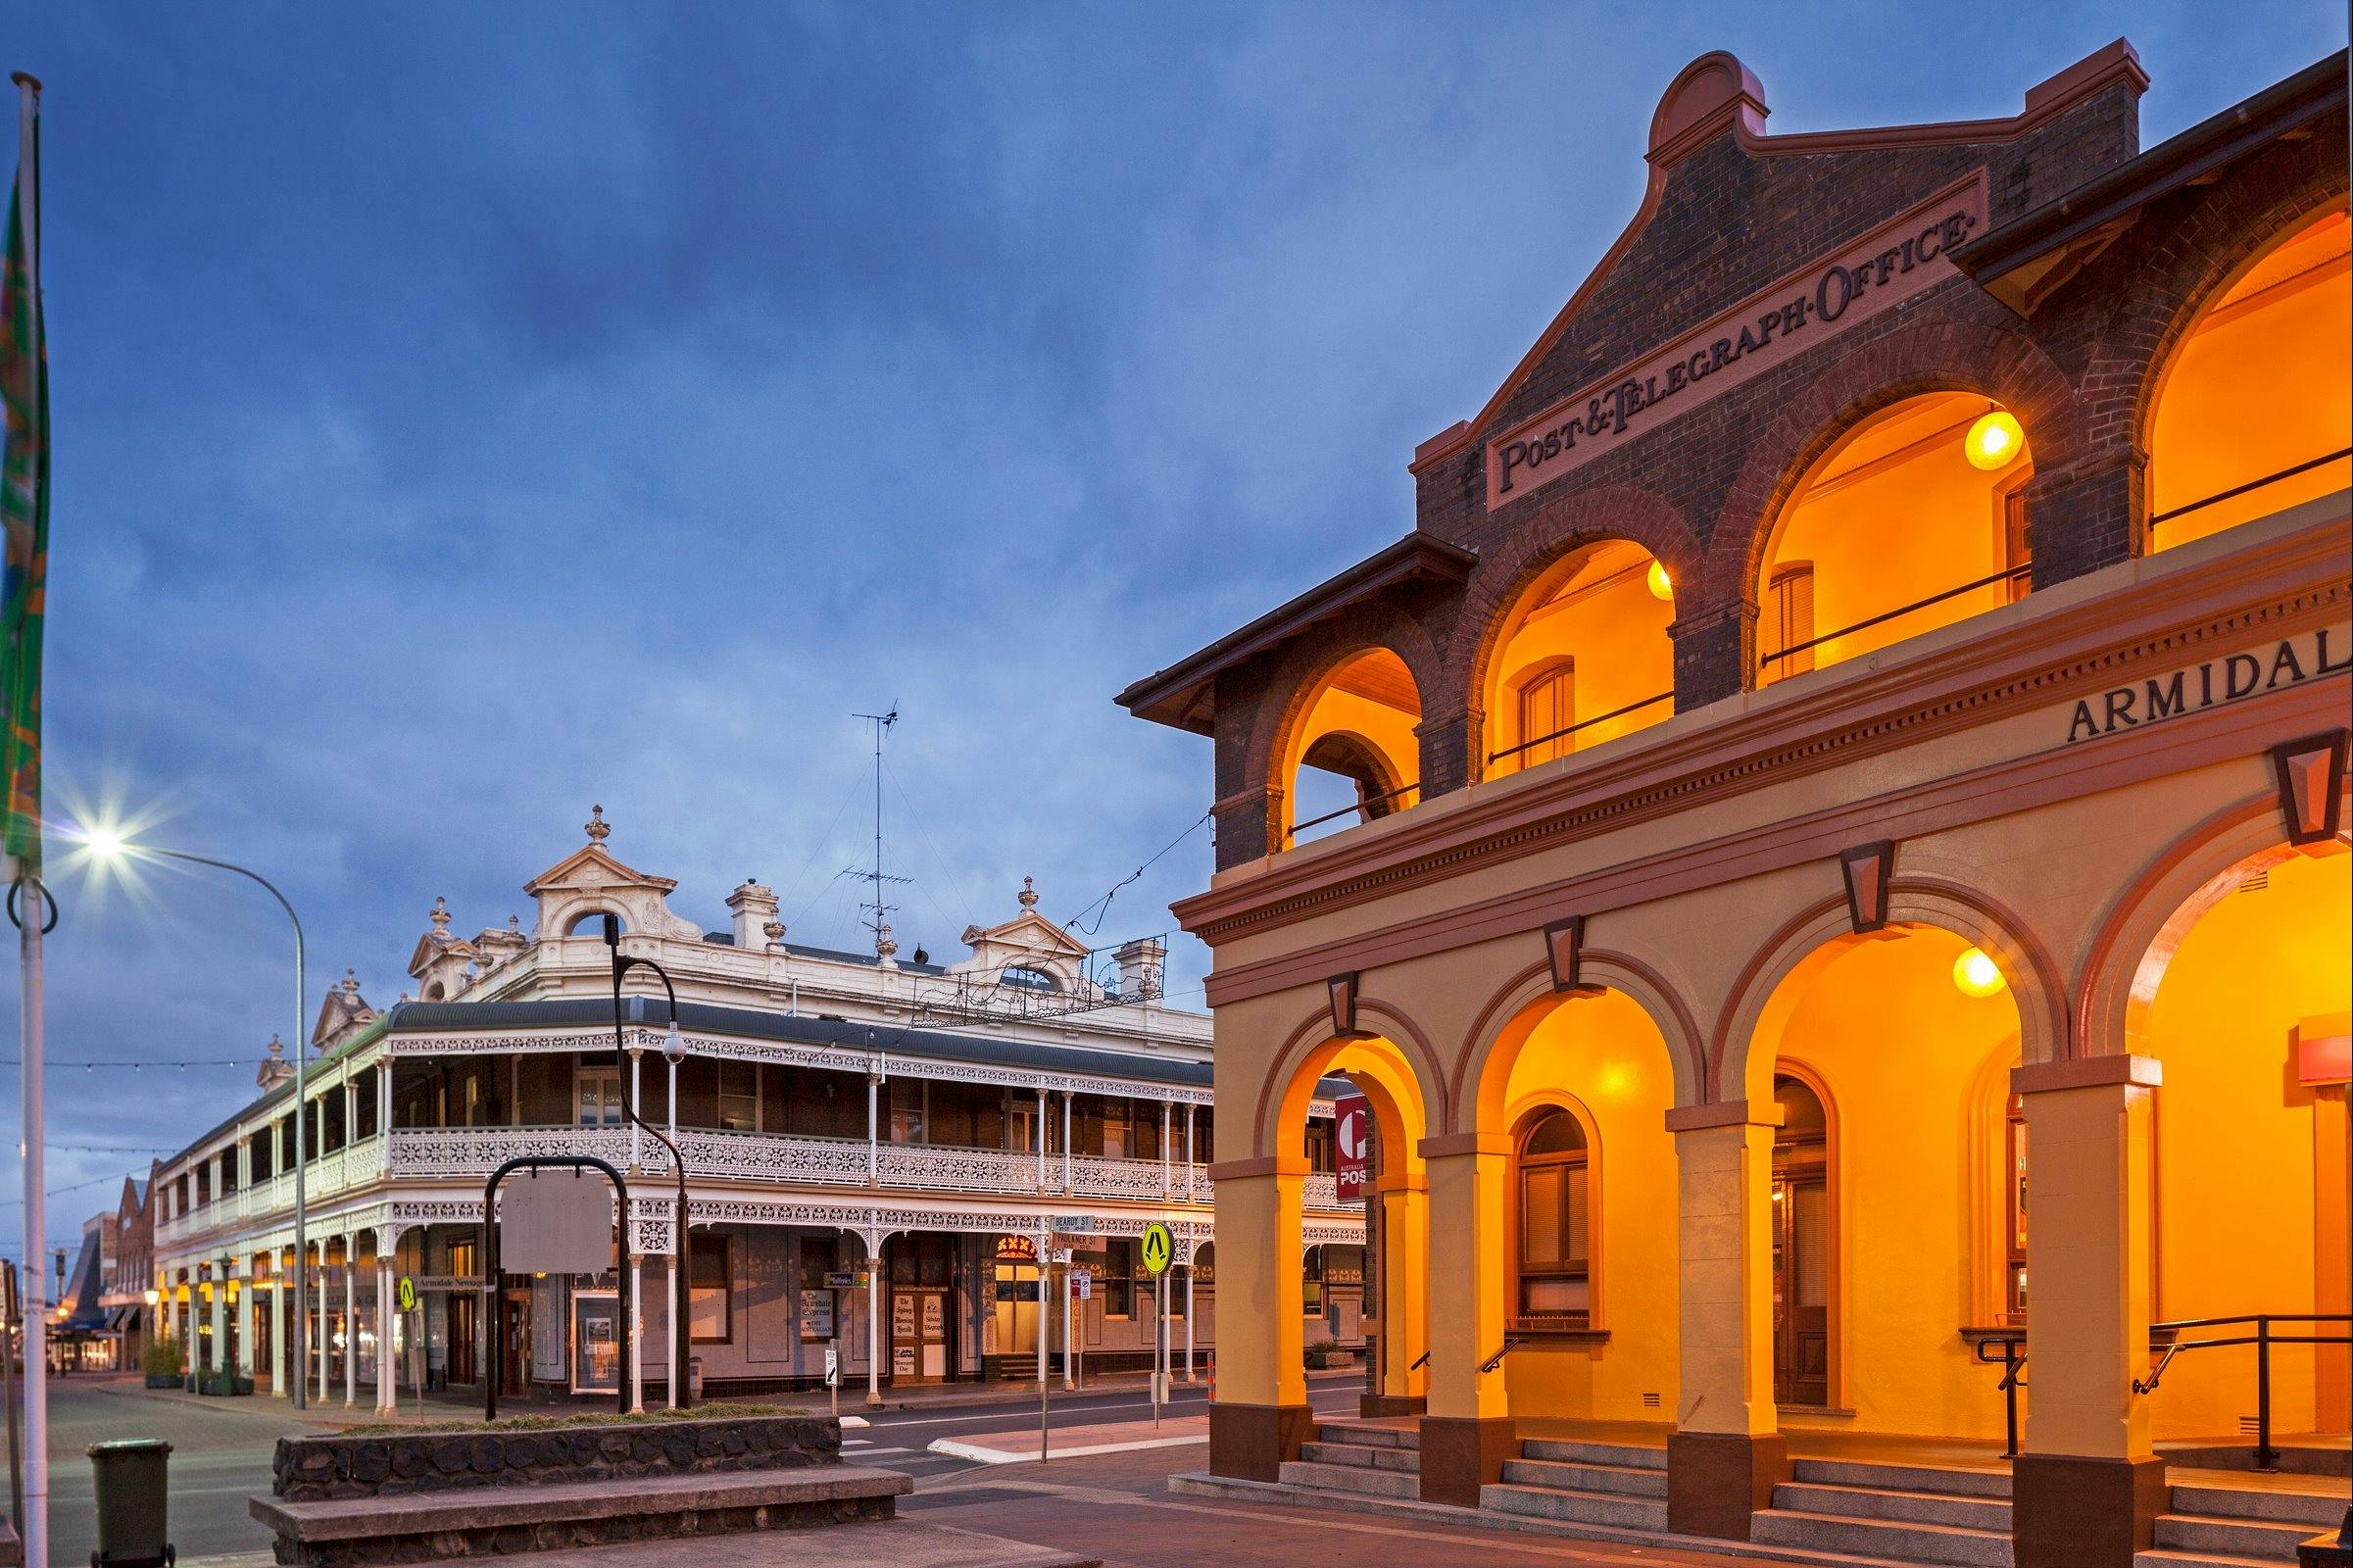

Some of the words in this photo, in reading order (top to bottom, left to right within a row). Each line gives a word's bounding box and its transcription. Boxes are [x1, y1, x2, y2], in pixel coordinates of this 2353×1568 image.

[1602, 296, 1807, 435] TELEGRAPH
[1815, 210, 1968, 322] OFFICE
[2067, 629, 2352, 742] ARMIDAL
[1341, 1170, 1366, 1185] POS
[1055, 1217, 1078, 1226] BEARDY
[1081, 1216, 1089, 1225] ST
[1057, 1233, 1086, 1244] FAULKNER
[1089, 1236, 1096, 1245] ST
[420, 1278, 453, 1287] Armidale
[455, 1278, 485, 1288] Newsage
[802, 1307, 830, 1317] Express
